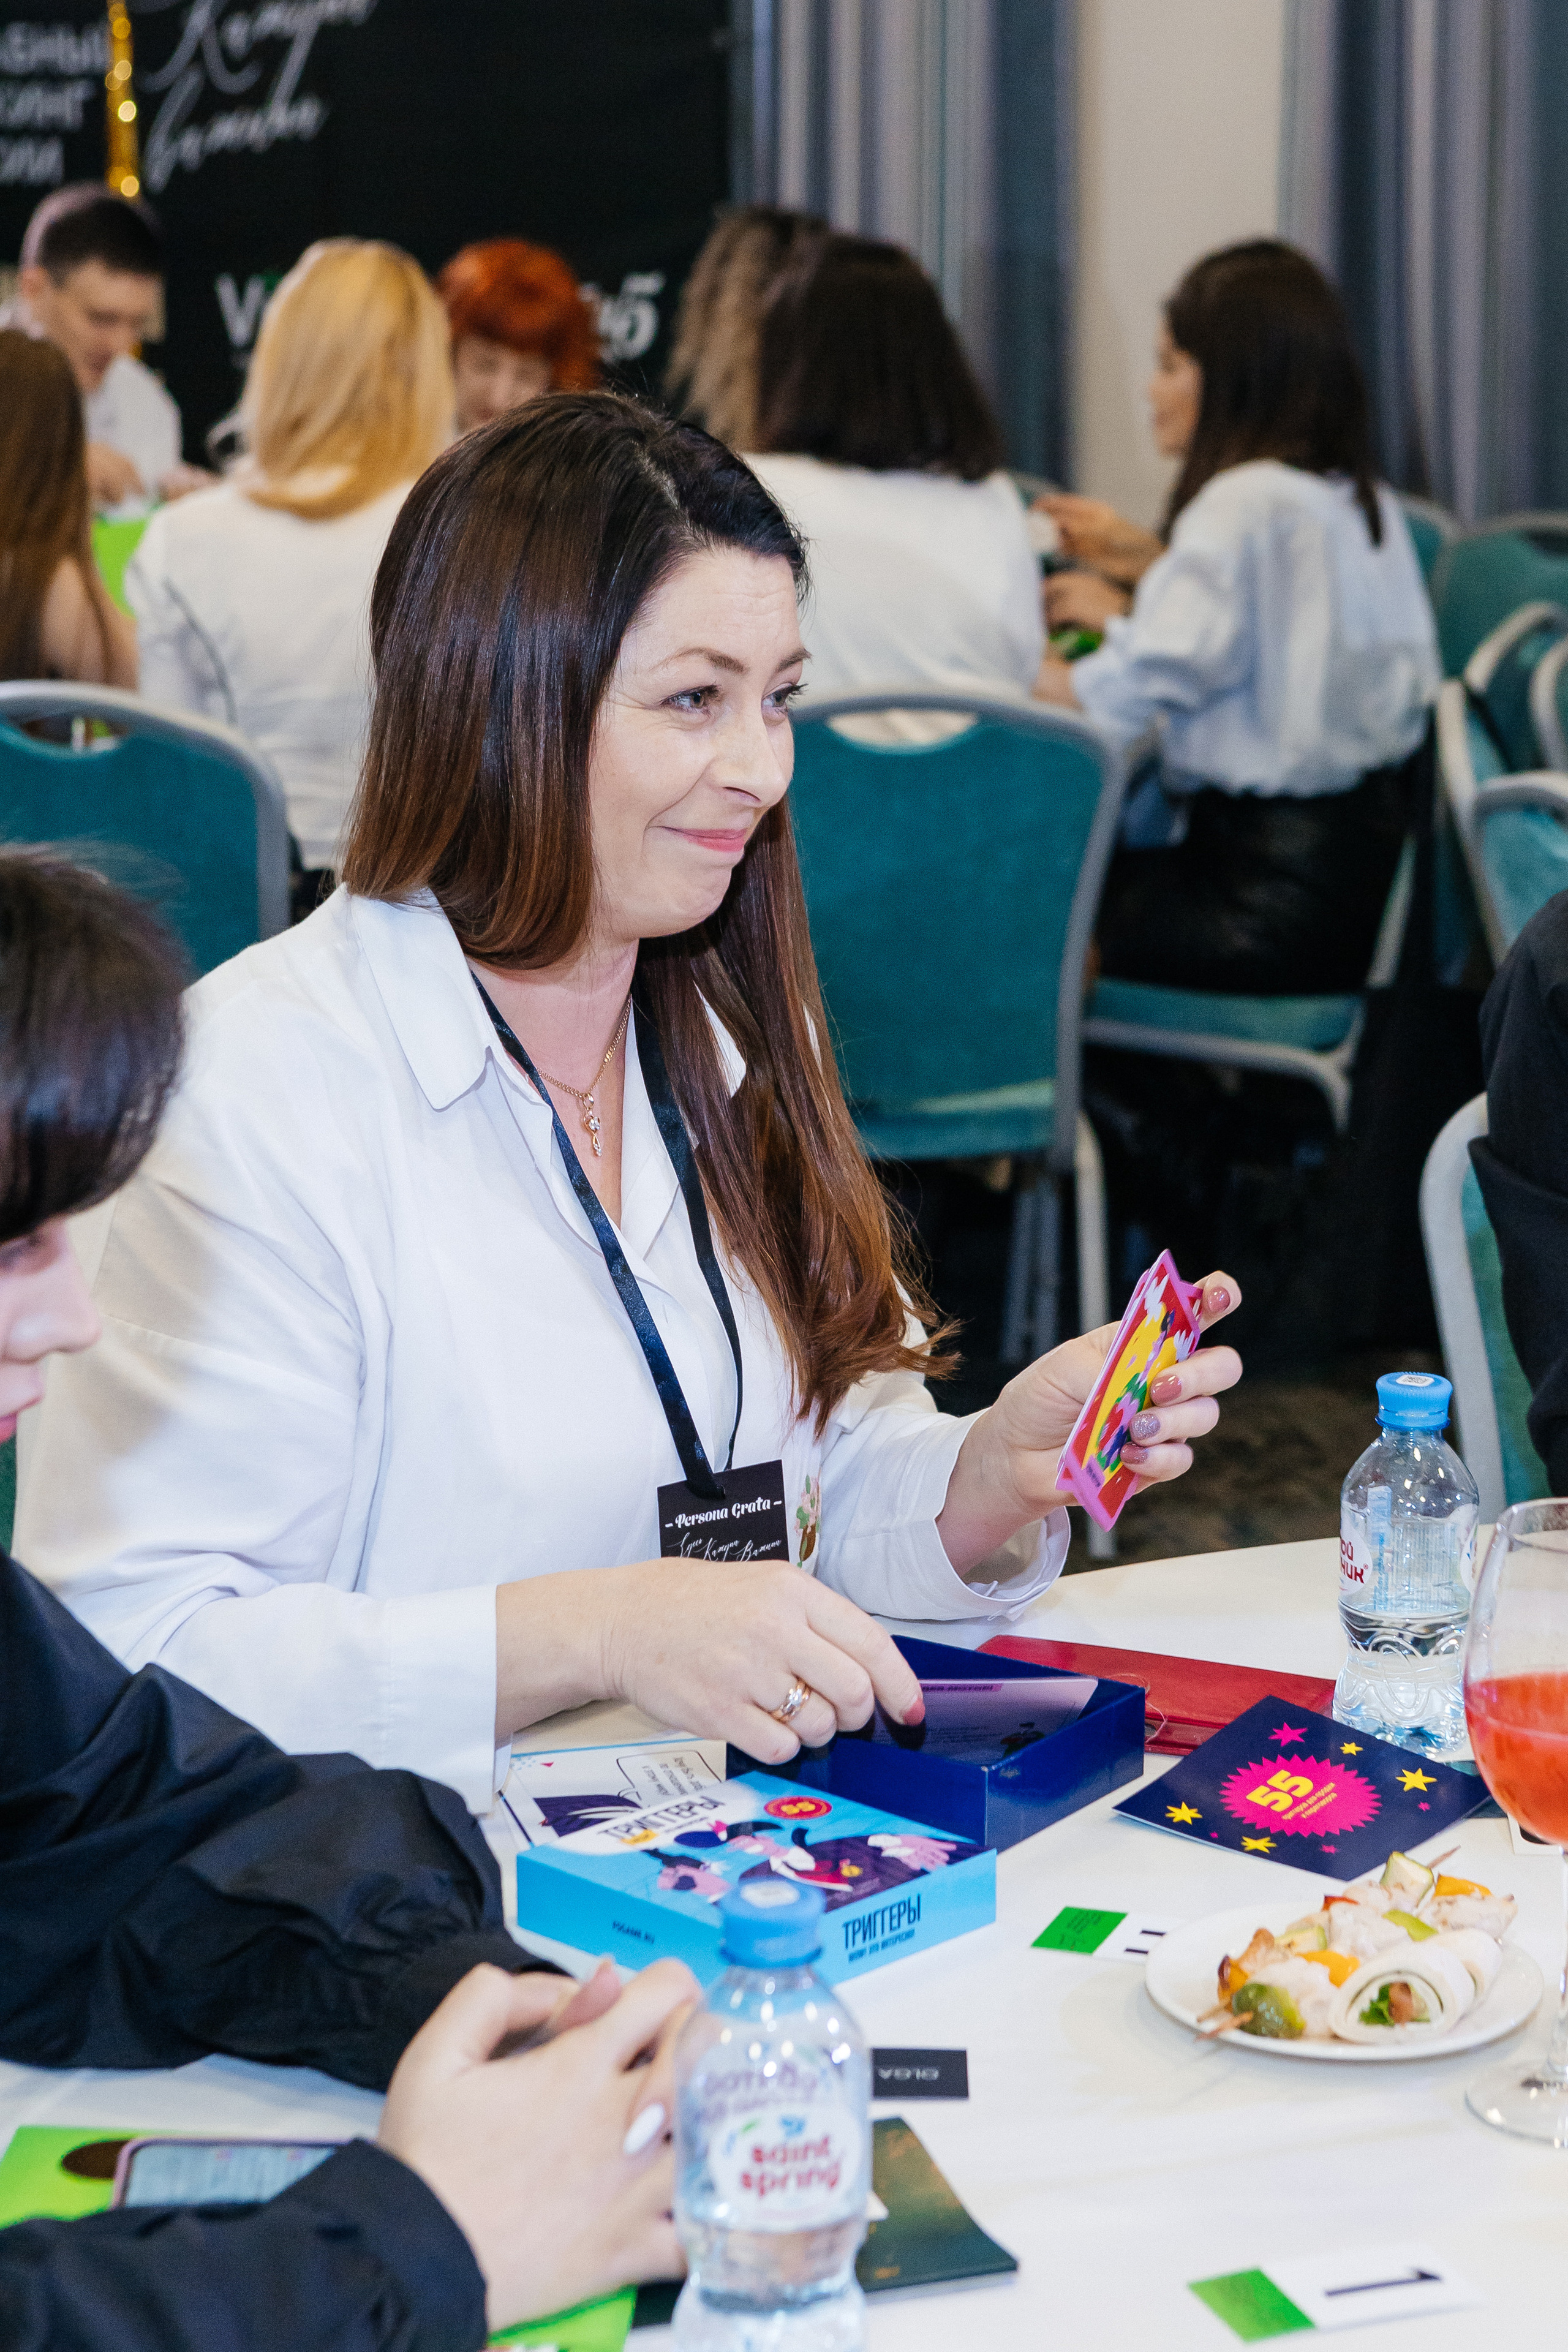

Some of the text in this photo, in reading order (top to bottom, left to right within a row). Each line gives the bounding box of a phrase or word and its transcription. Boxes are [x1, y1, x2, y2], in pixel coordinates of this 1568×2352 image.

[675, 1496, 771, 1529] Persona Grata
[1245, 1768, 1314, 1813] 55
[842, 1893, 921, 1950] ТРИГГЕРЫ
[751, 2133, 832, 2165] saint
[740, 2158, 842, 2199] spring
